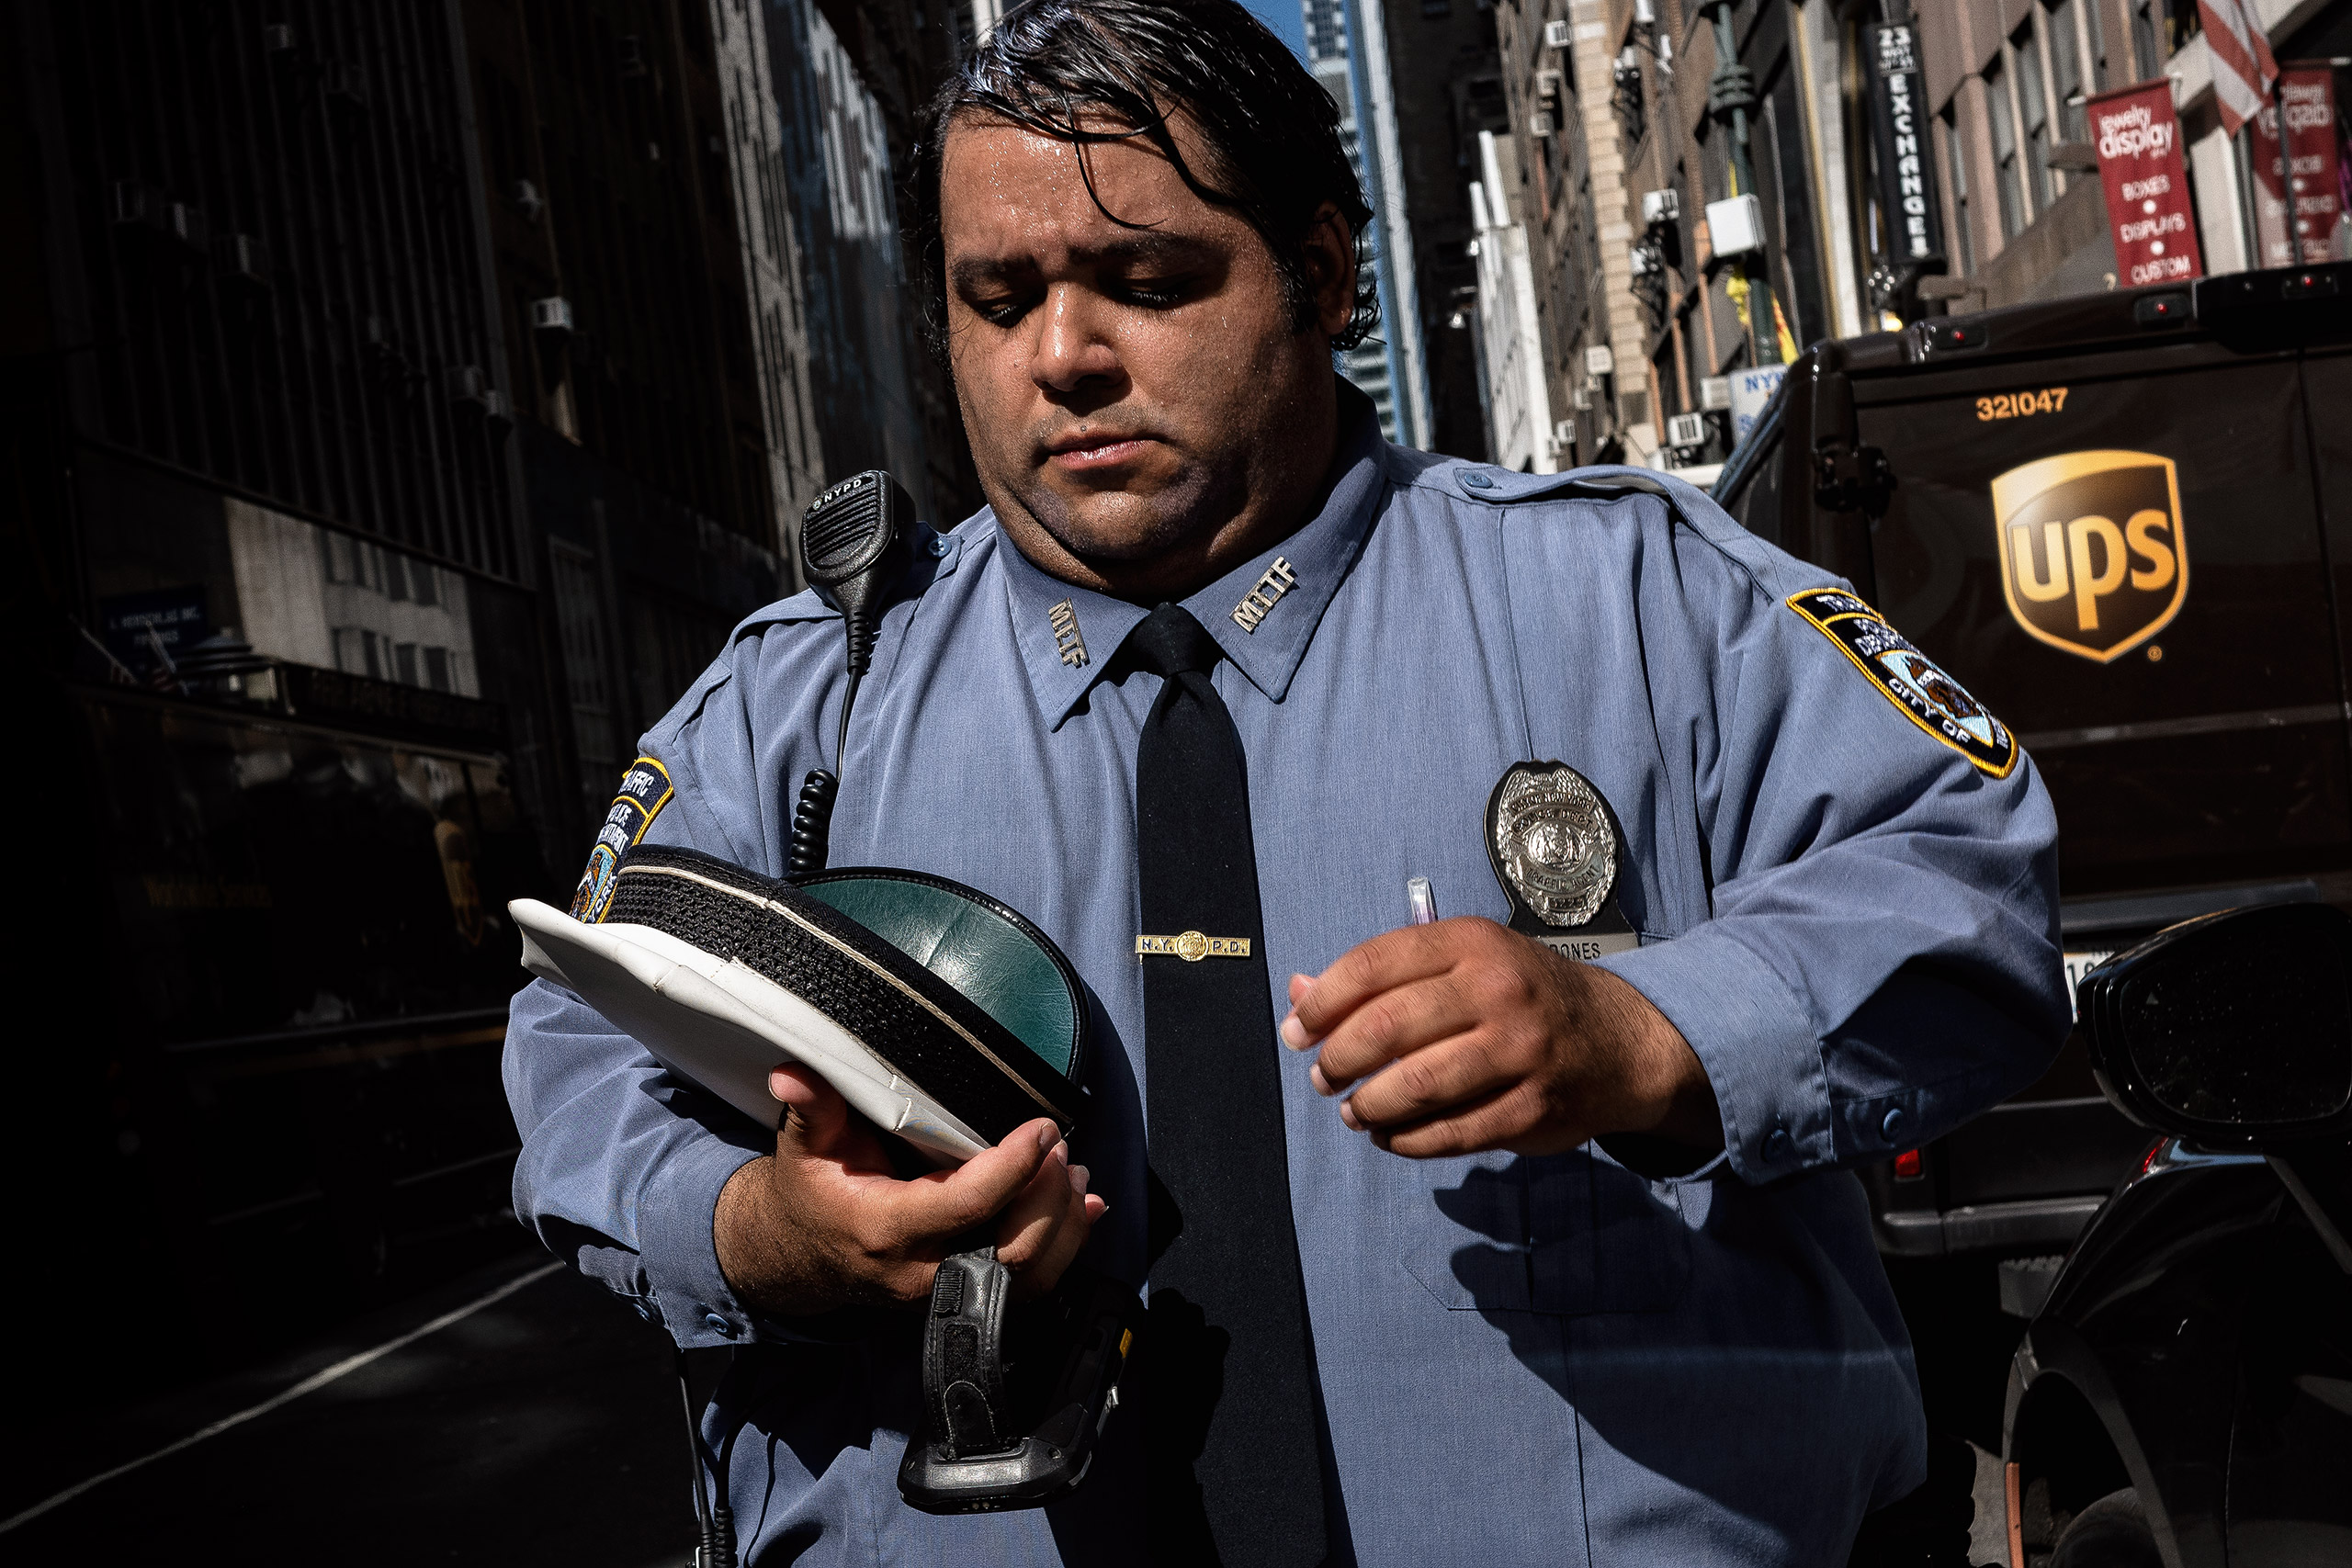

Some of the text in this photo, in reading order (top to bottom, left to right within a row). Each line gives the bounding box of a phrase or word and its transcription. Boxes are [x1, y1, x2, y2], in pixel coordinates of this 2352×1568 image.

[1878, 27, 1911, 47] 23
[2097, 104, 2151, 138] jewelry
[1889, 73, 1926, 236] EXCHANGE
[2098, 120, 2173, 160] display
[2121, 174, 2170, 201] BOXES
[2120, 212, 2186, 243] DISPLAYS
[2132, 254, 2191, 285] CUSTOM
[1976, 387, 2068, 421] 321047
[824, 479, 862, 502] NYPD
[2012, 509, 2176, 631] ups
[1228, 556, 1295, 634] MTTF
[1047, 597, 1088, 668] MTTF
[1888, 678, 1938, 718] CITY
[1941, 719, 1971, 743] OF
[1513, 808, 1555, 833] POLICE
[1526, 864, 1600, 890] TRAFFIC AGENT
[588, 872, 616, 923] YORK
[1142, 938, 1246, 953] N.Y. P.D.
